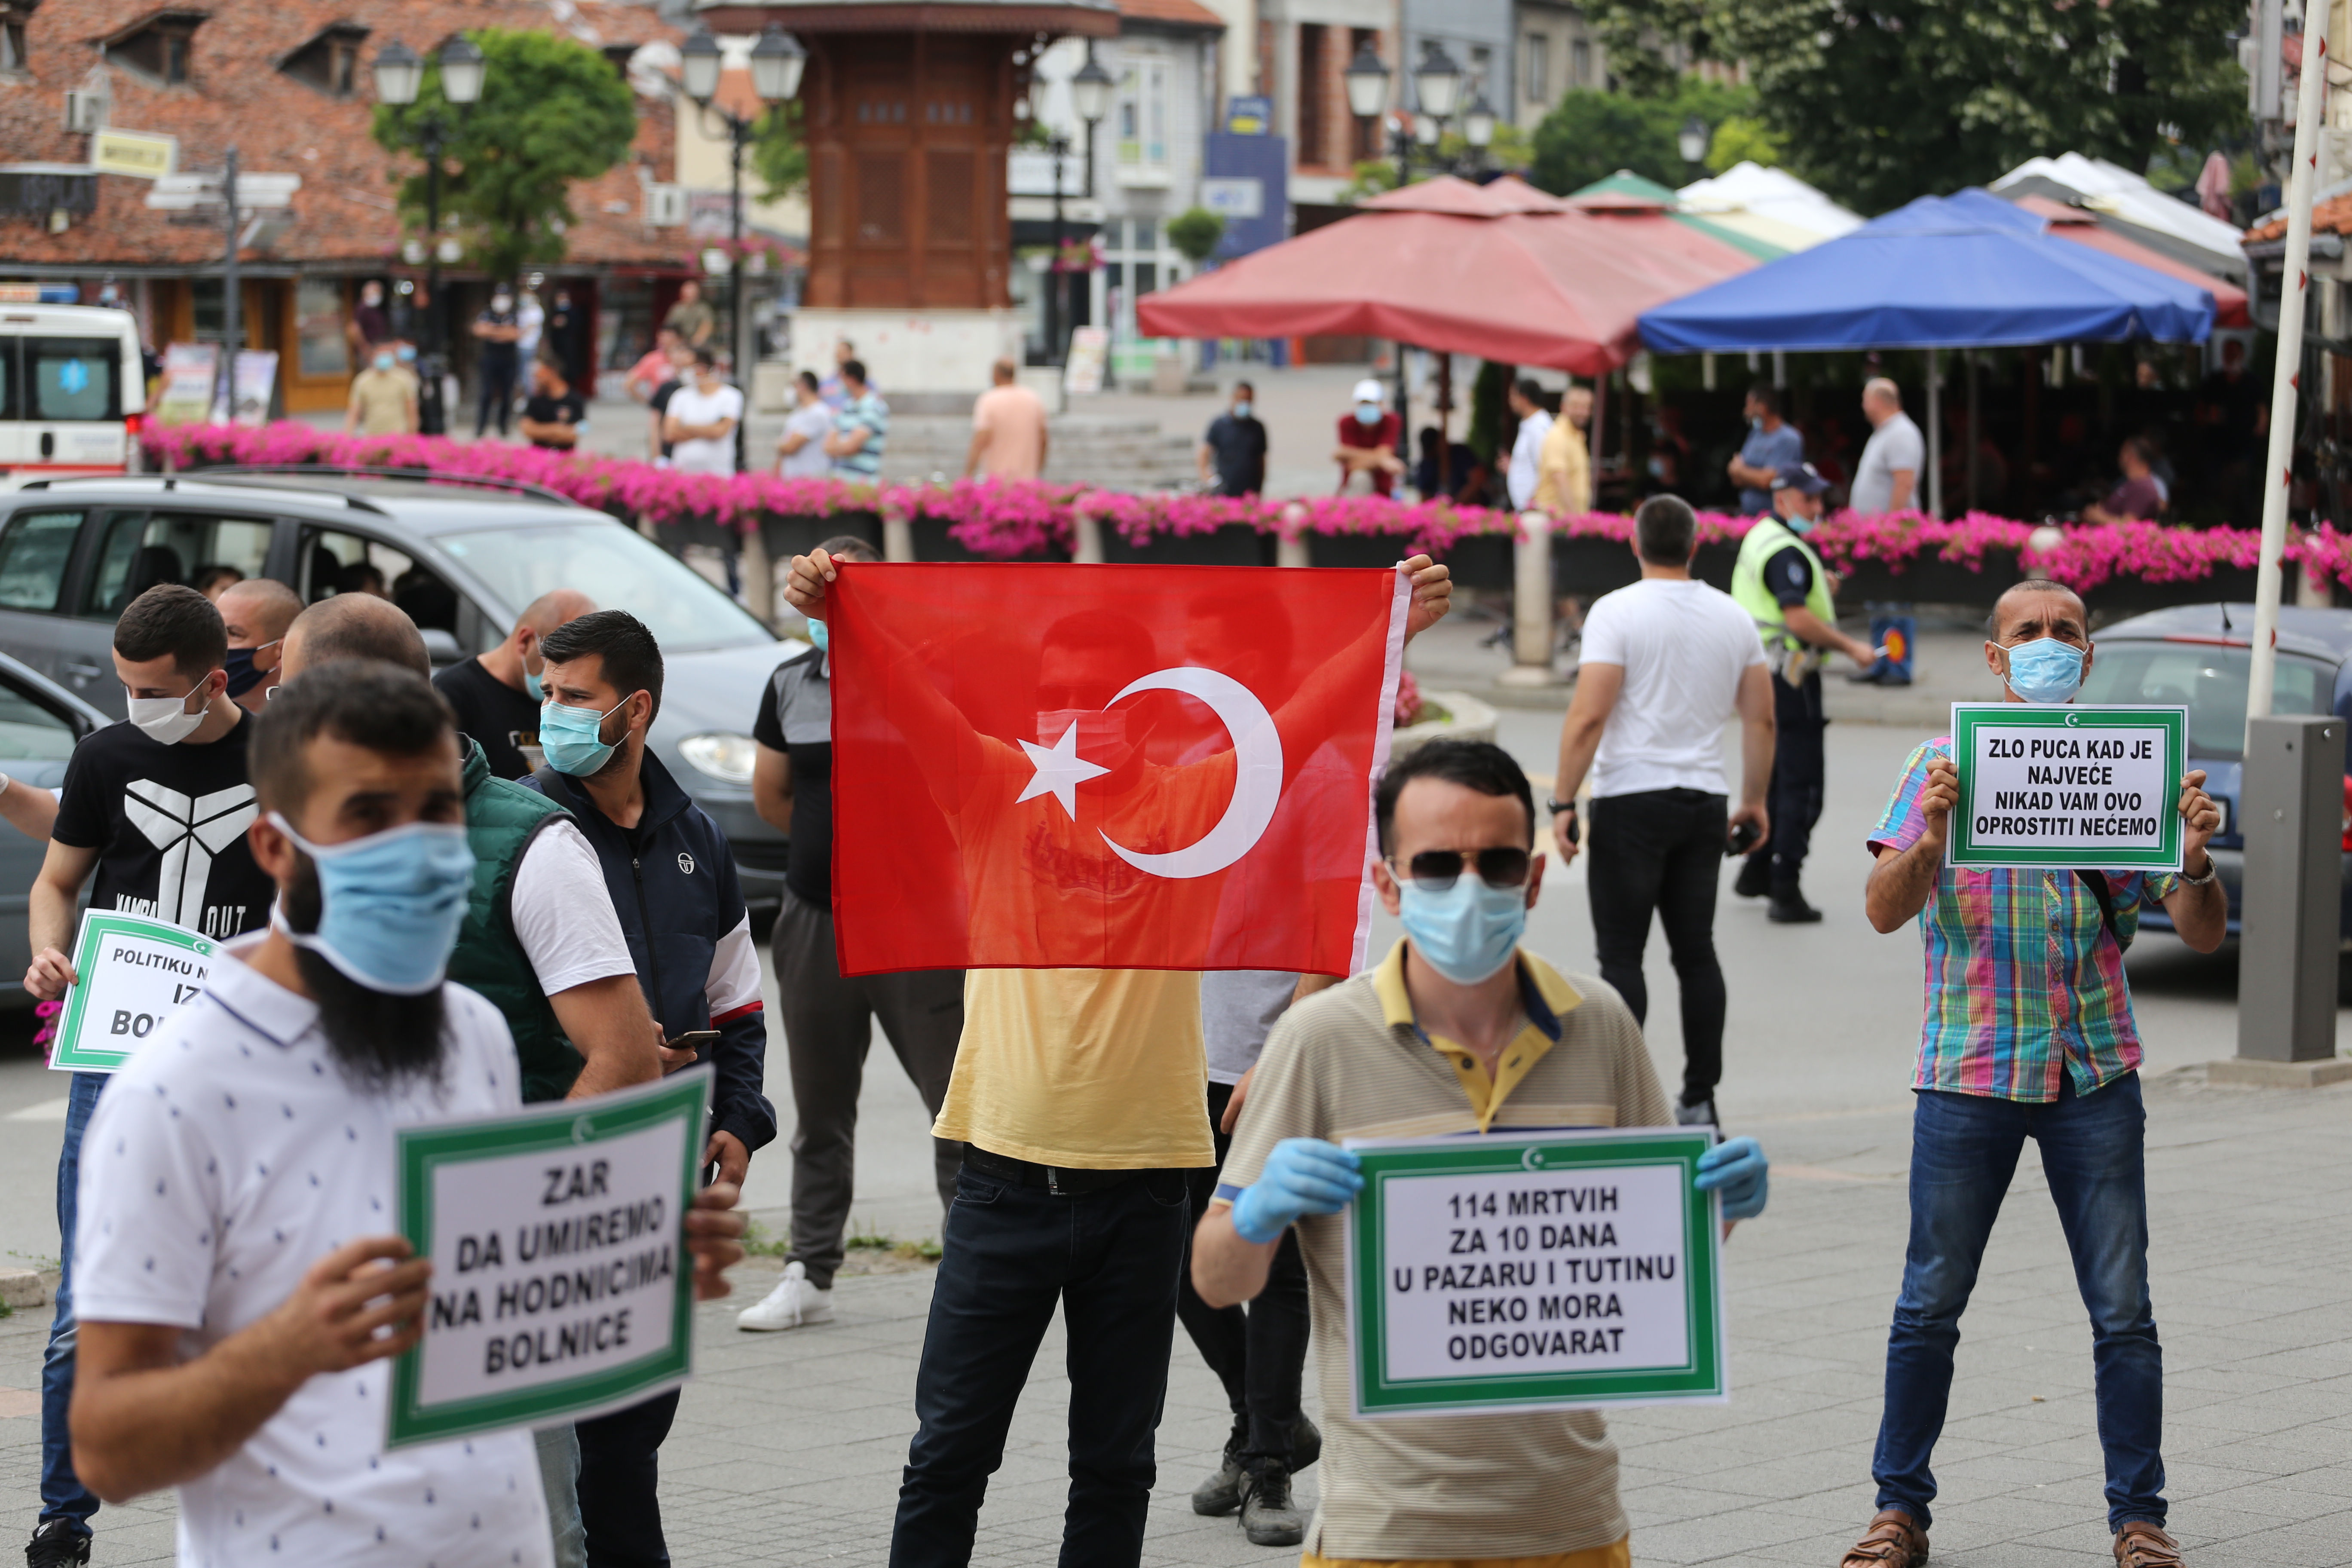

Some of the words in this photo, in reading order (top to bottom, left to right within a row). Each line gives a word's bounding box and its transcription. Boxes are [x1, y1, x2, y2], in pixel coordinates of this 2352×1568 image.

[1989, 739, 2024, 758] ZLO
[2031, 740, 2080, 758] PUCA
[2087, 740, 2124, 759] KAD
[2130, 741, 2151, 759] JE
[2028, 762, 2112, 784] NAJVEĆE
[1996, 792, 2052, 809] NIKAD
[2060, 792, 2098, 810] VAM
[2104, 793, 2141, 811] OVO
[1976, 816, 2073, 835] OPROSTITI
[2080, 814, 2156, 836] NEĆEMO
[205, 906, 246, 937] OUT
[113, 948, 192, 975] POLITIKU
[542, 1160, 609, 1207] ZAR
[1449, 1193, 1497, 1218] 114
[1508, 1187, 1617, 1215] MRTVIH
[457, 1233, 503, 1274] DA
[518, 1196, 666, 1264] UMIREMO
[1450, 1229, 1486, 1254] ZA
[1498, 1226, 1528, 1251] 10
[1540, 1223, 1617, 1250] DANA
[430, 1289, 481, 1331] NA
[496, 1245, 674, 1320] HODNICIMA
[1395, 1268, 1412, 1292] U
[1424, 1262, 1535, 1290] PAZARU
[1549, 1261, 1554, 1284] I
[1566, 1256, 1674, 1283] TUTINU
[1449, 1297, 1527, 1324] NEKO
[1540, 1293, 1622, 1320] MORA
[486, 1308, 631, 1375] BOLNICE
[1449, 1328, 1624, 1360] ODGOVARAT
